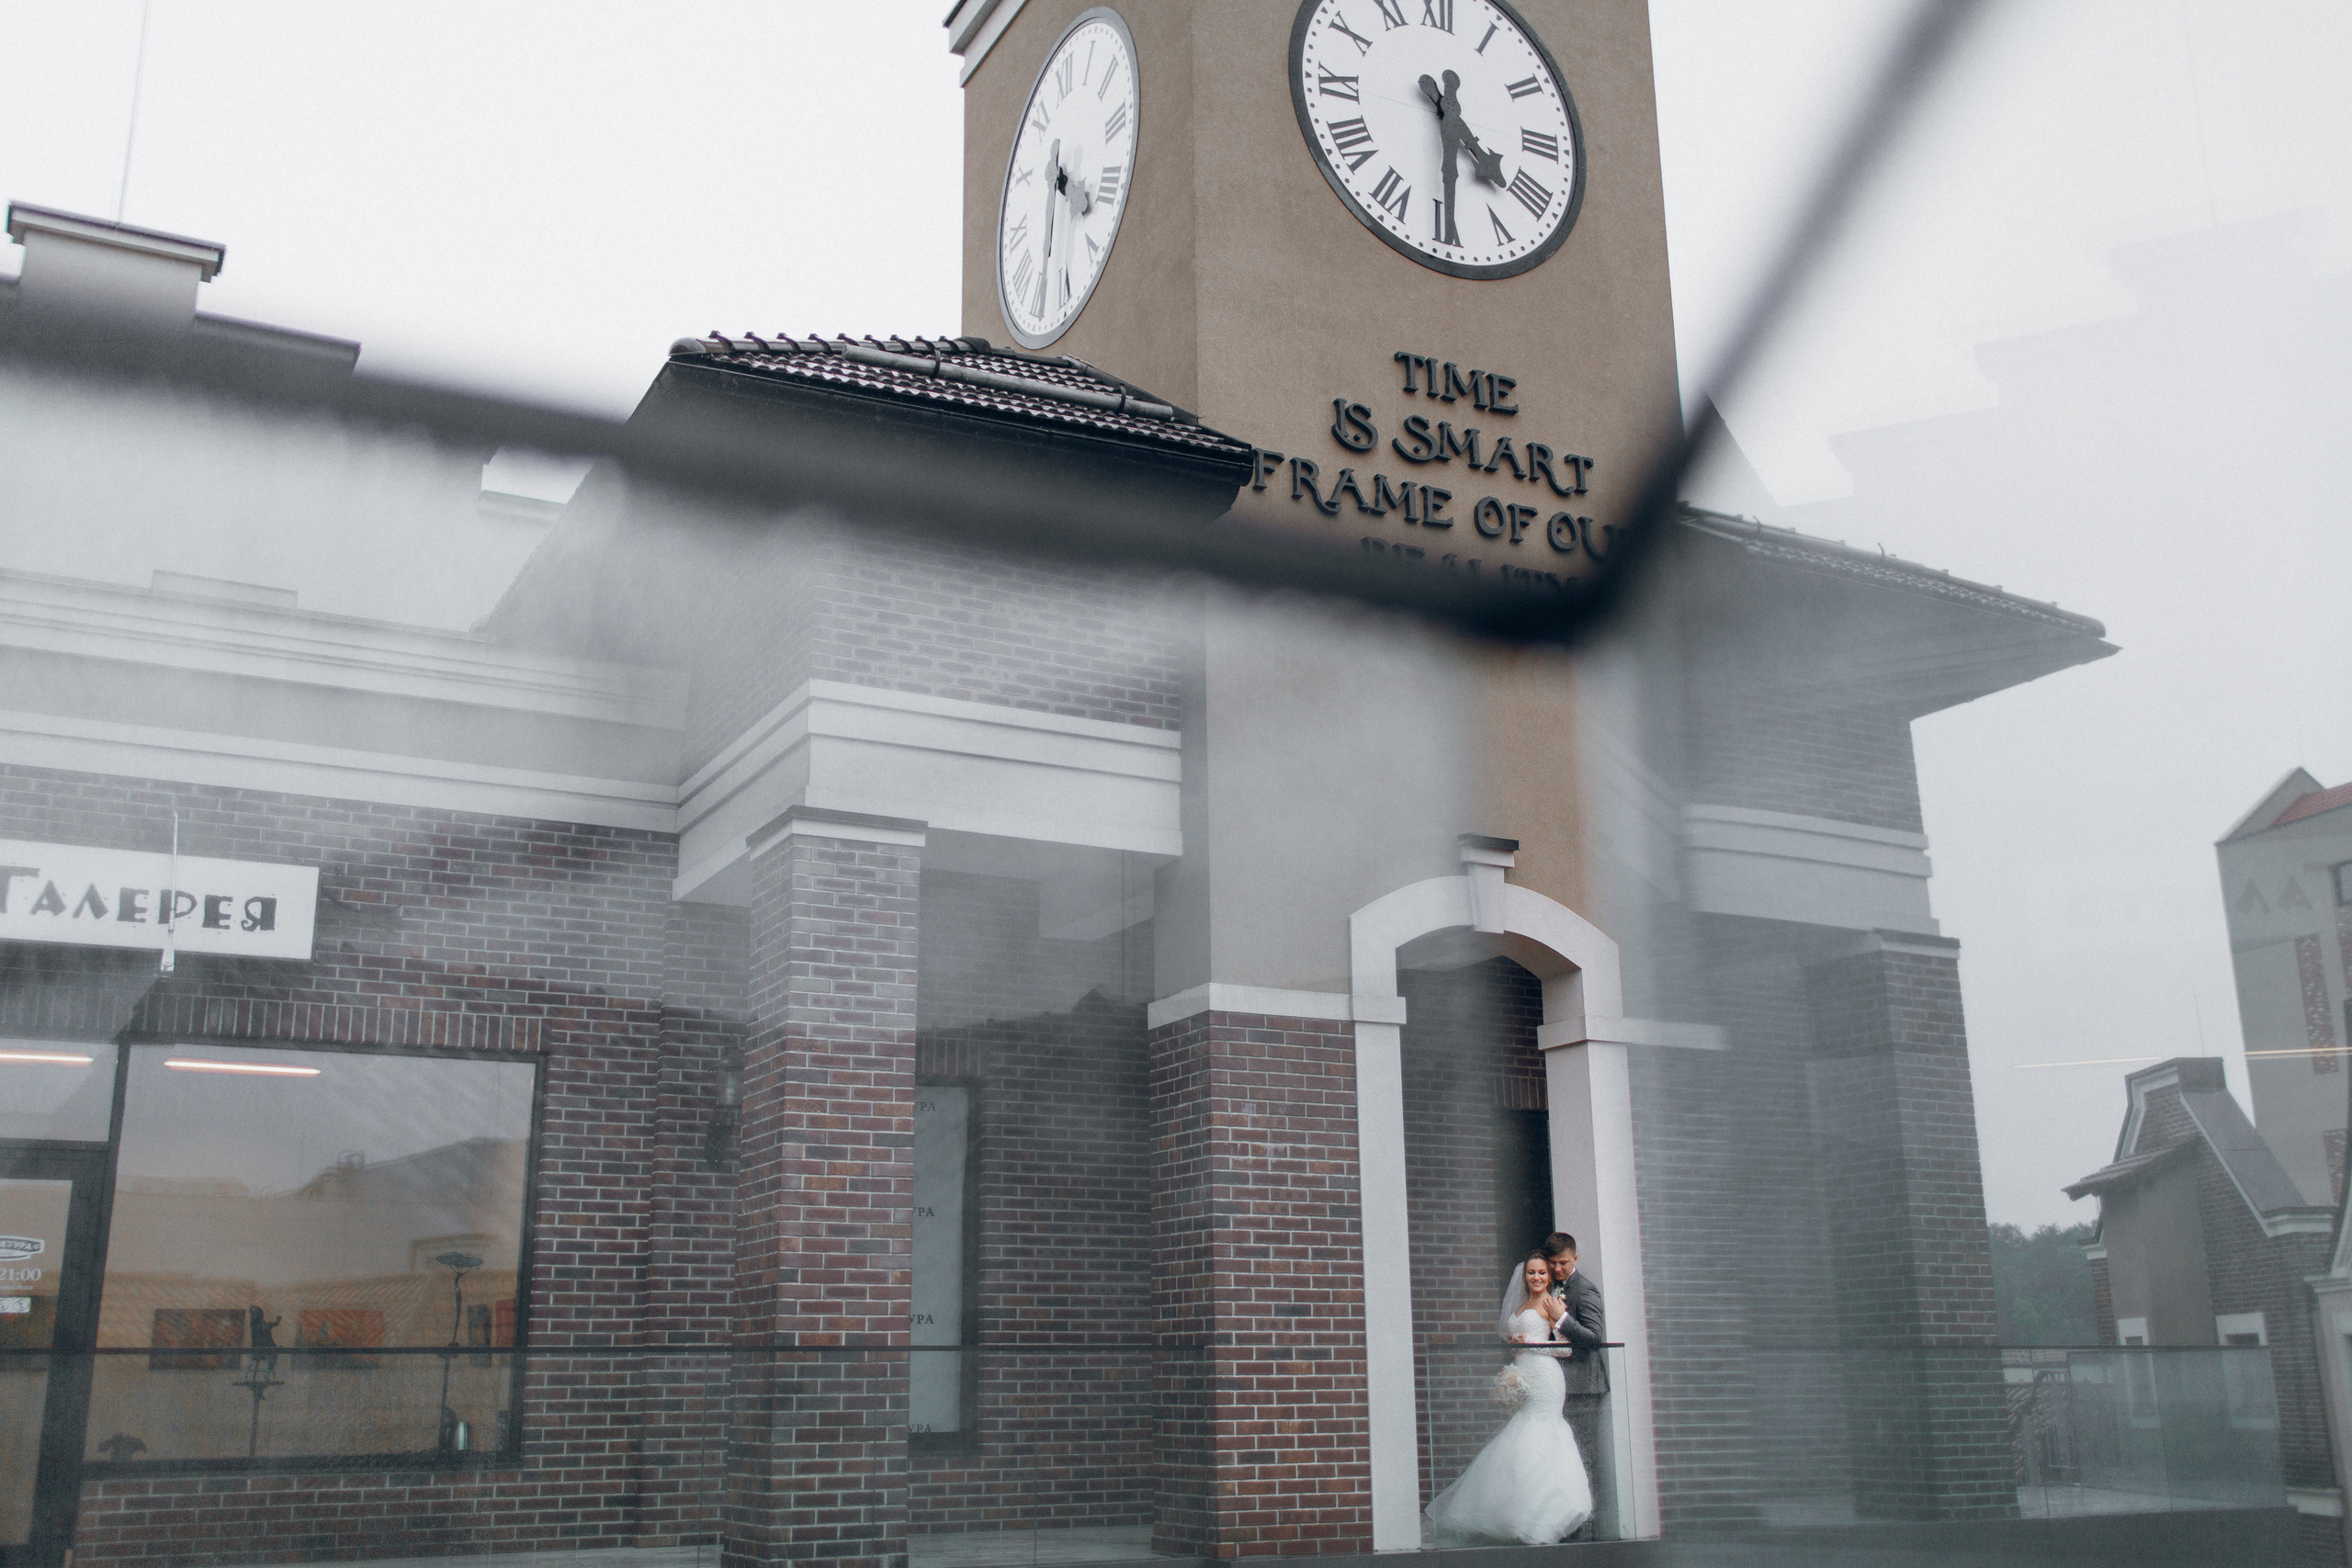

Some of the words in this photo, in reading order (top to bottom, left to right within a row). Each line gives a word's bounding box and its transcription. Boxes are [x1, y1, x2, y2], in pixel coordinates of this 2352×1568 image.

[1394, 351, 1520, 415] TIME
[1331, 398, 1378, 452] IS
[1391, 414, 1594, 497] SMART
[1252, 447, 1454, 528] FRAME
[1474, 495, 1539, 544] OF
[1546, 511, 1634, 563] OU
[0, 864, 277, 932] ГАЛЕРЕЯ
